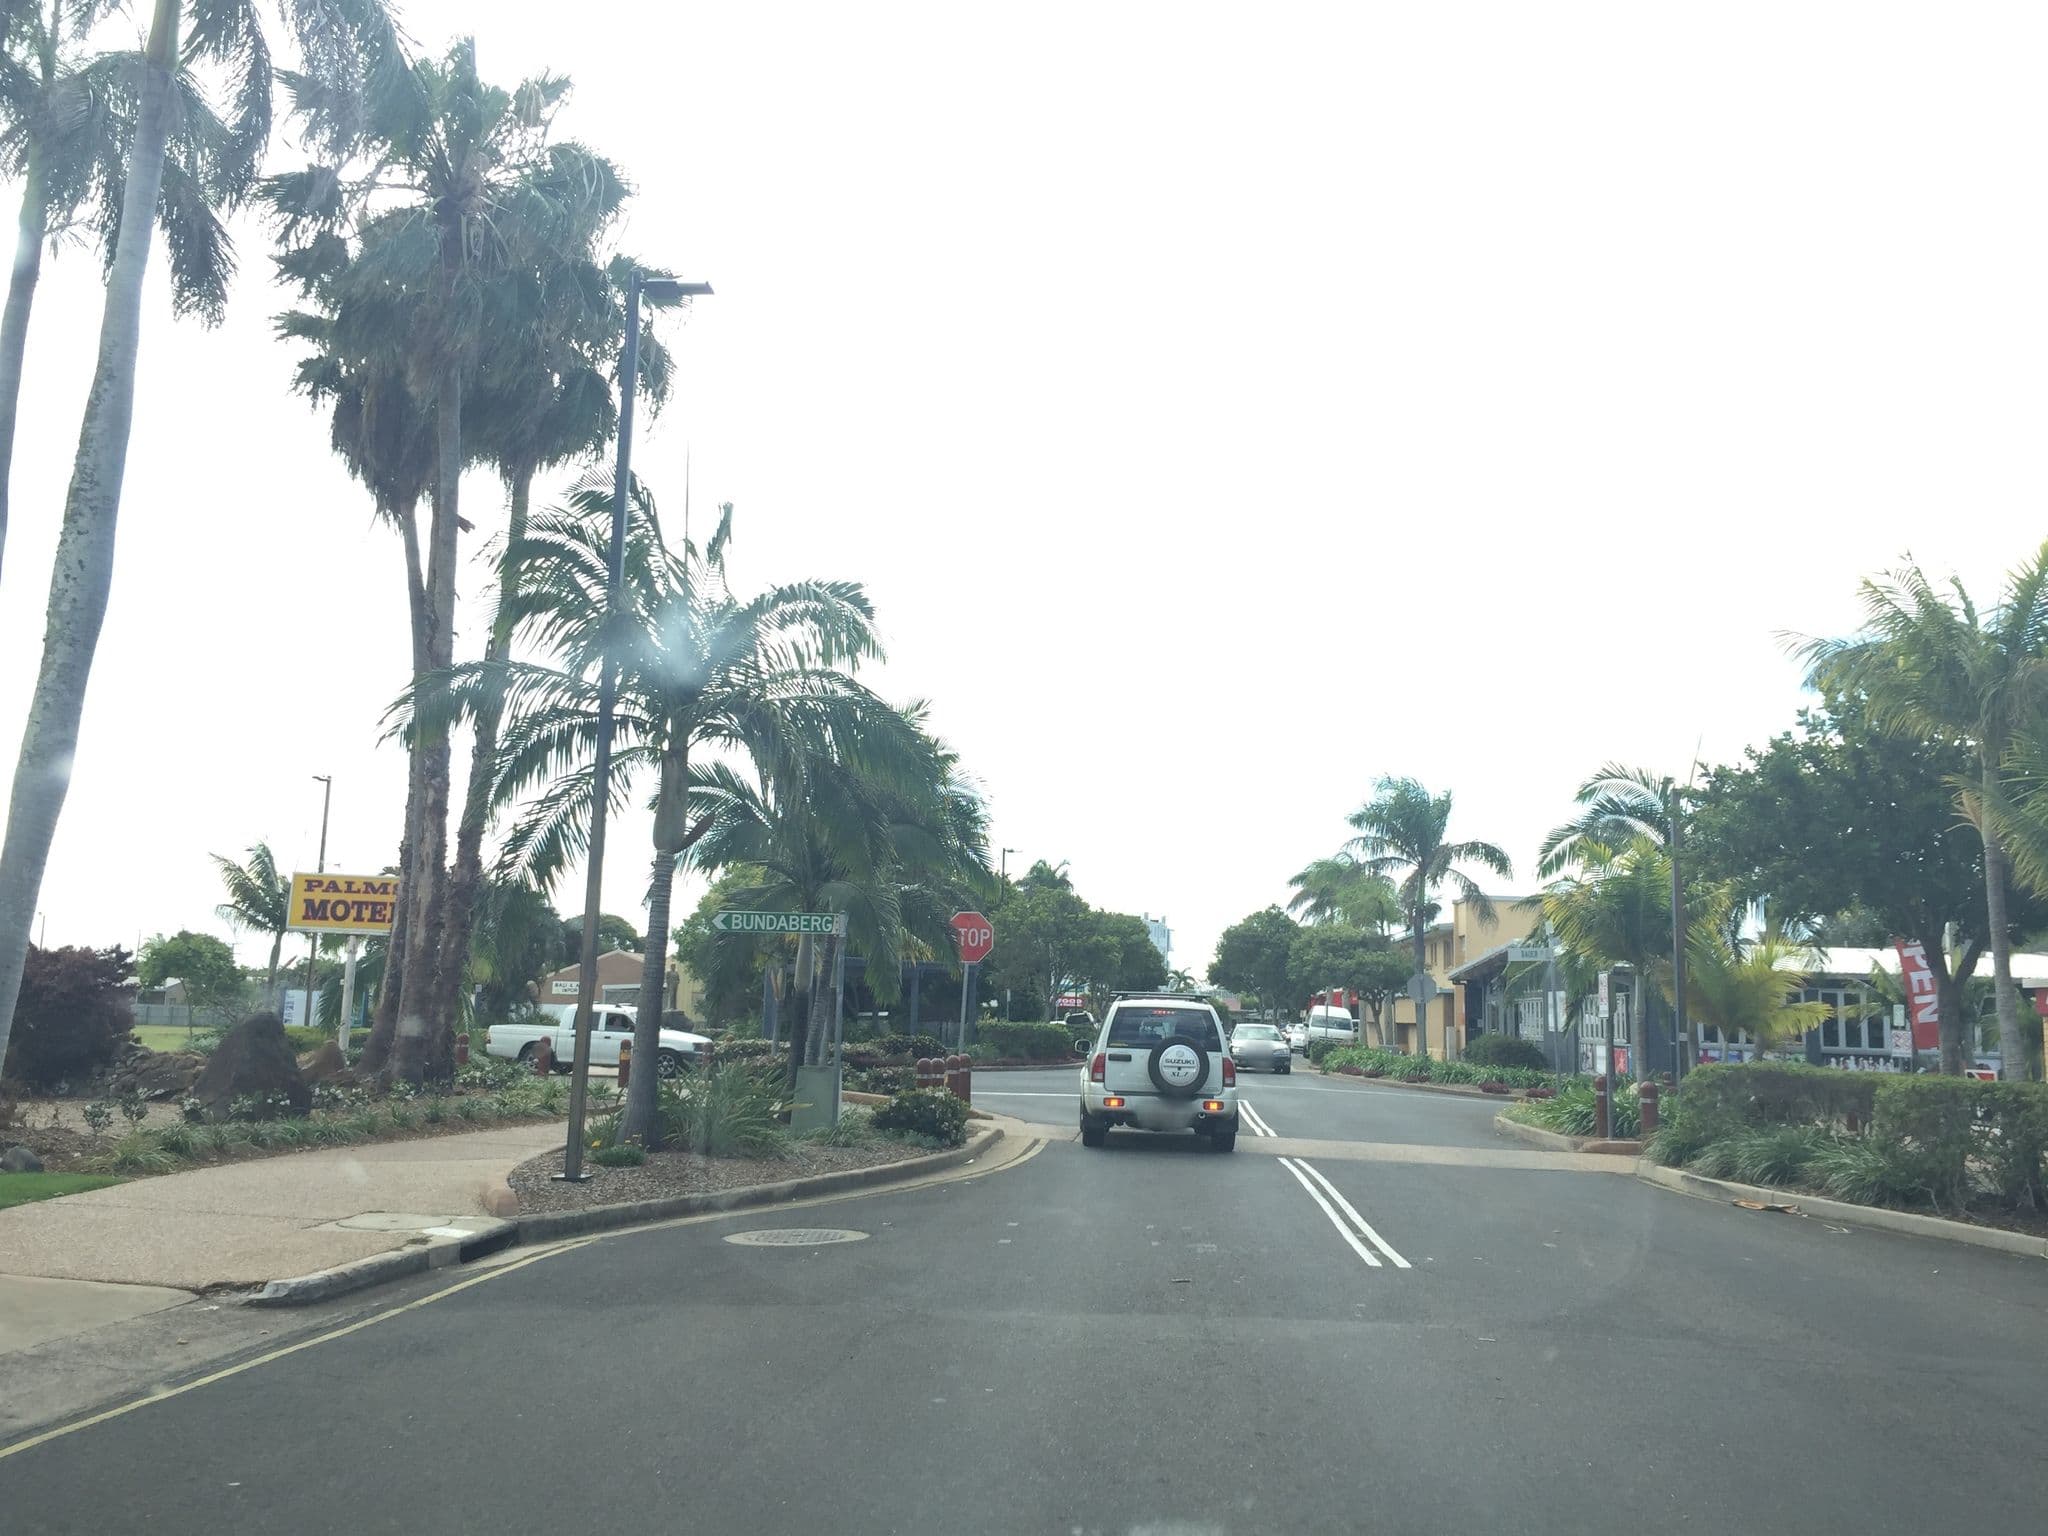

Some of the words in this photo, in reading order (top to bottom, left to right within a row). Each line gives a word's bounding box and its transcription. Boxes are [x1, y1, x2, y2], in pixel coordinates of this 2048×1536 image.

[731, 914, 833, 931] BUNDABERG
[958, 928, 990, 947] TOP
[1903, 938, 1938, 1023] PEN
